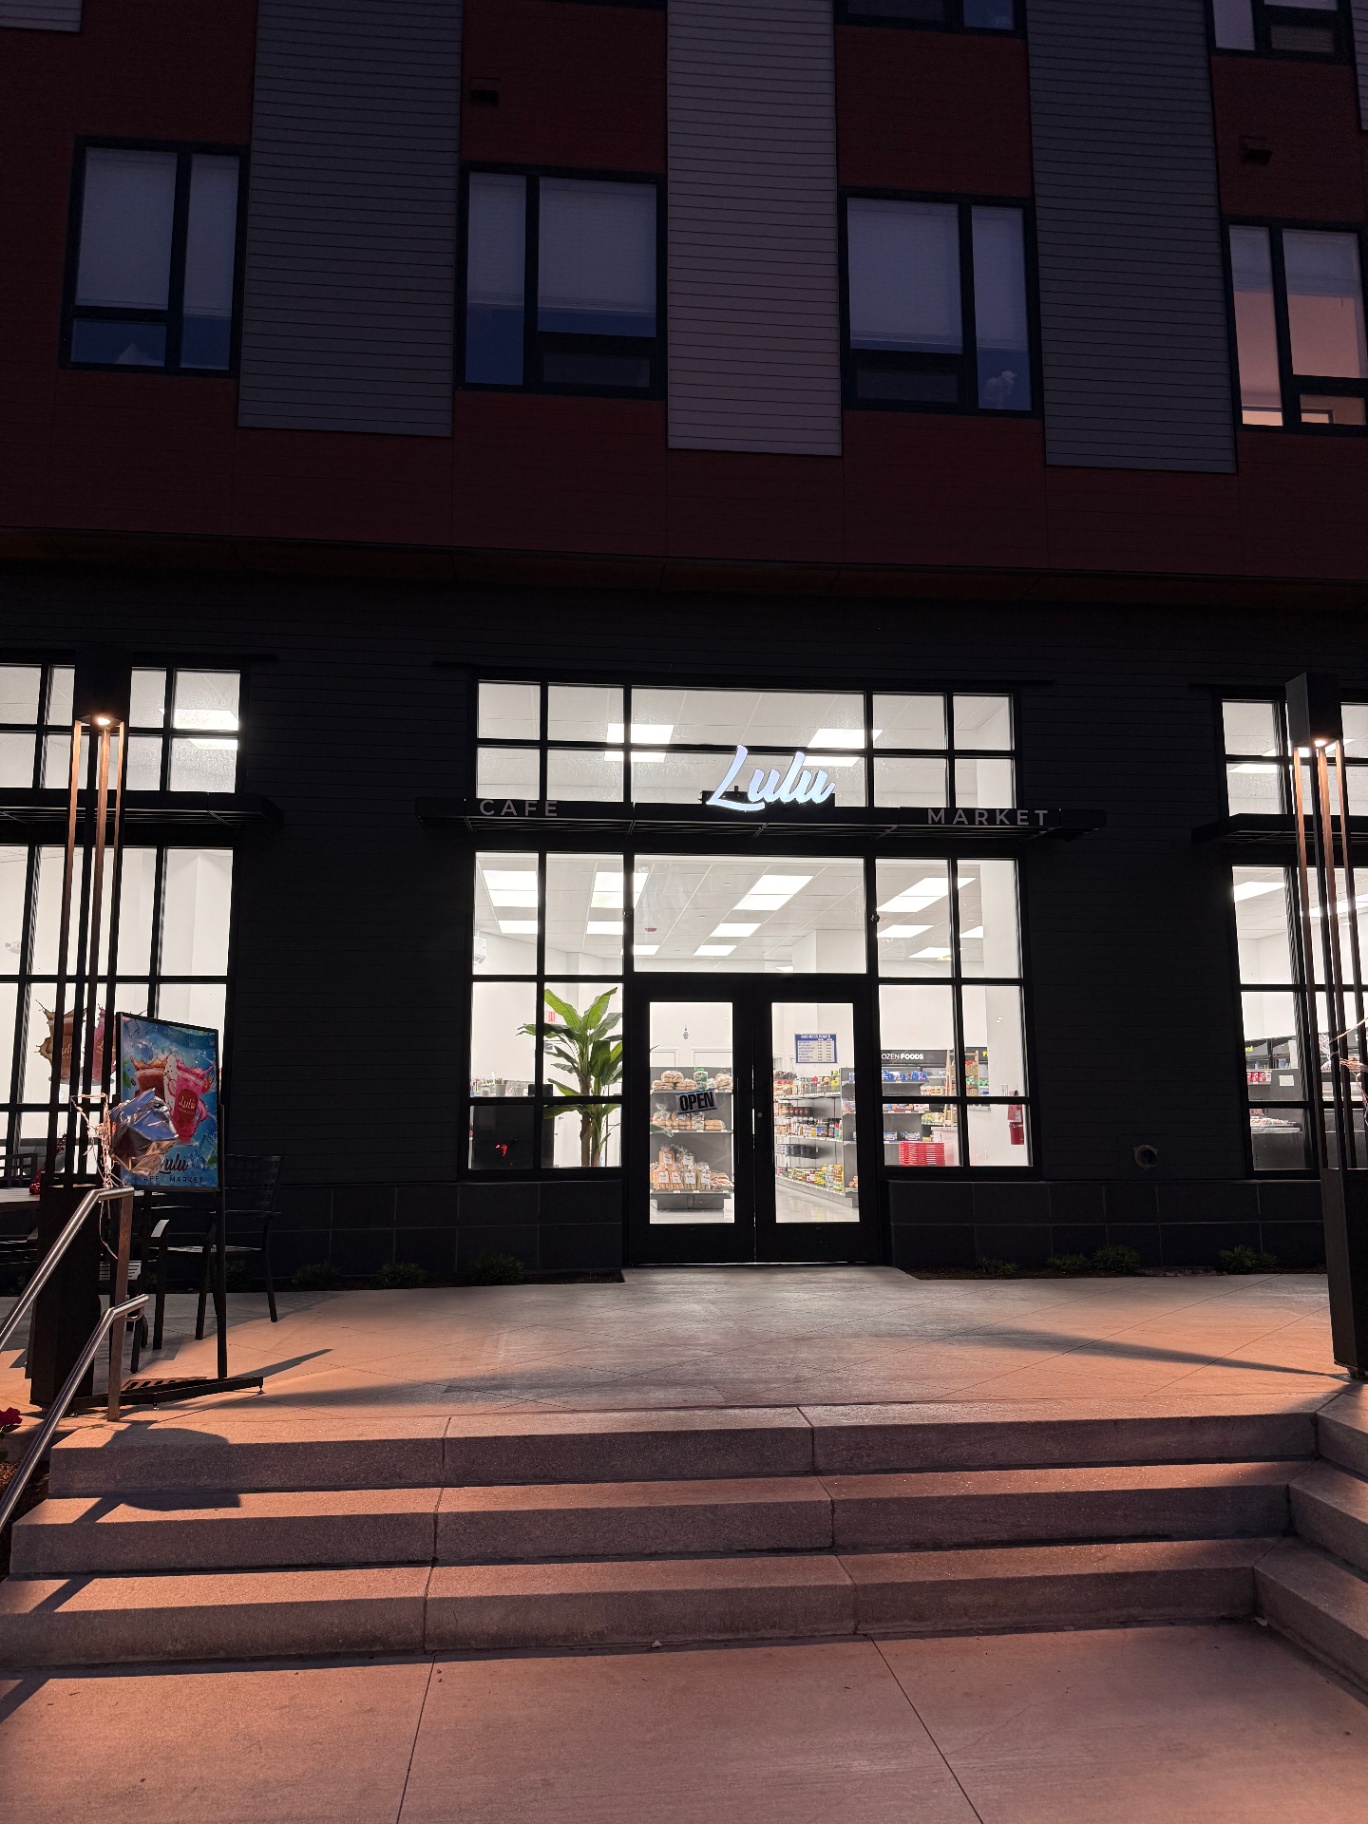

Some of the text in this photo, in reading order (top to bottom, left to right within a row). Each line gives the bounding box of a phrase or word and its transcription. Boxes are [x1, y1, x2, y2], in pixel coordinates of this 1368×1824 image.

[706, 744, 836, 812] Lulu
[479, 799, 559, 818] CAFE
[927, 808, 1049, 827] MARKET
[679, 1091, 715, 1111] OPEN
[169, 1176, 204, 1184] MARKET
